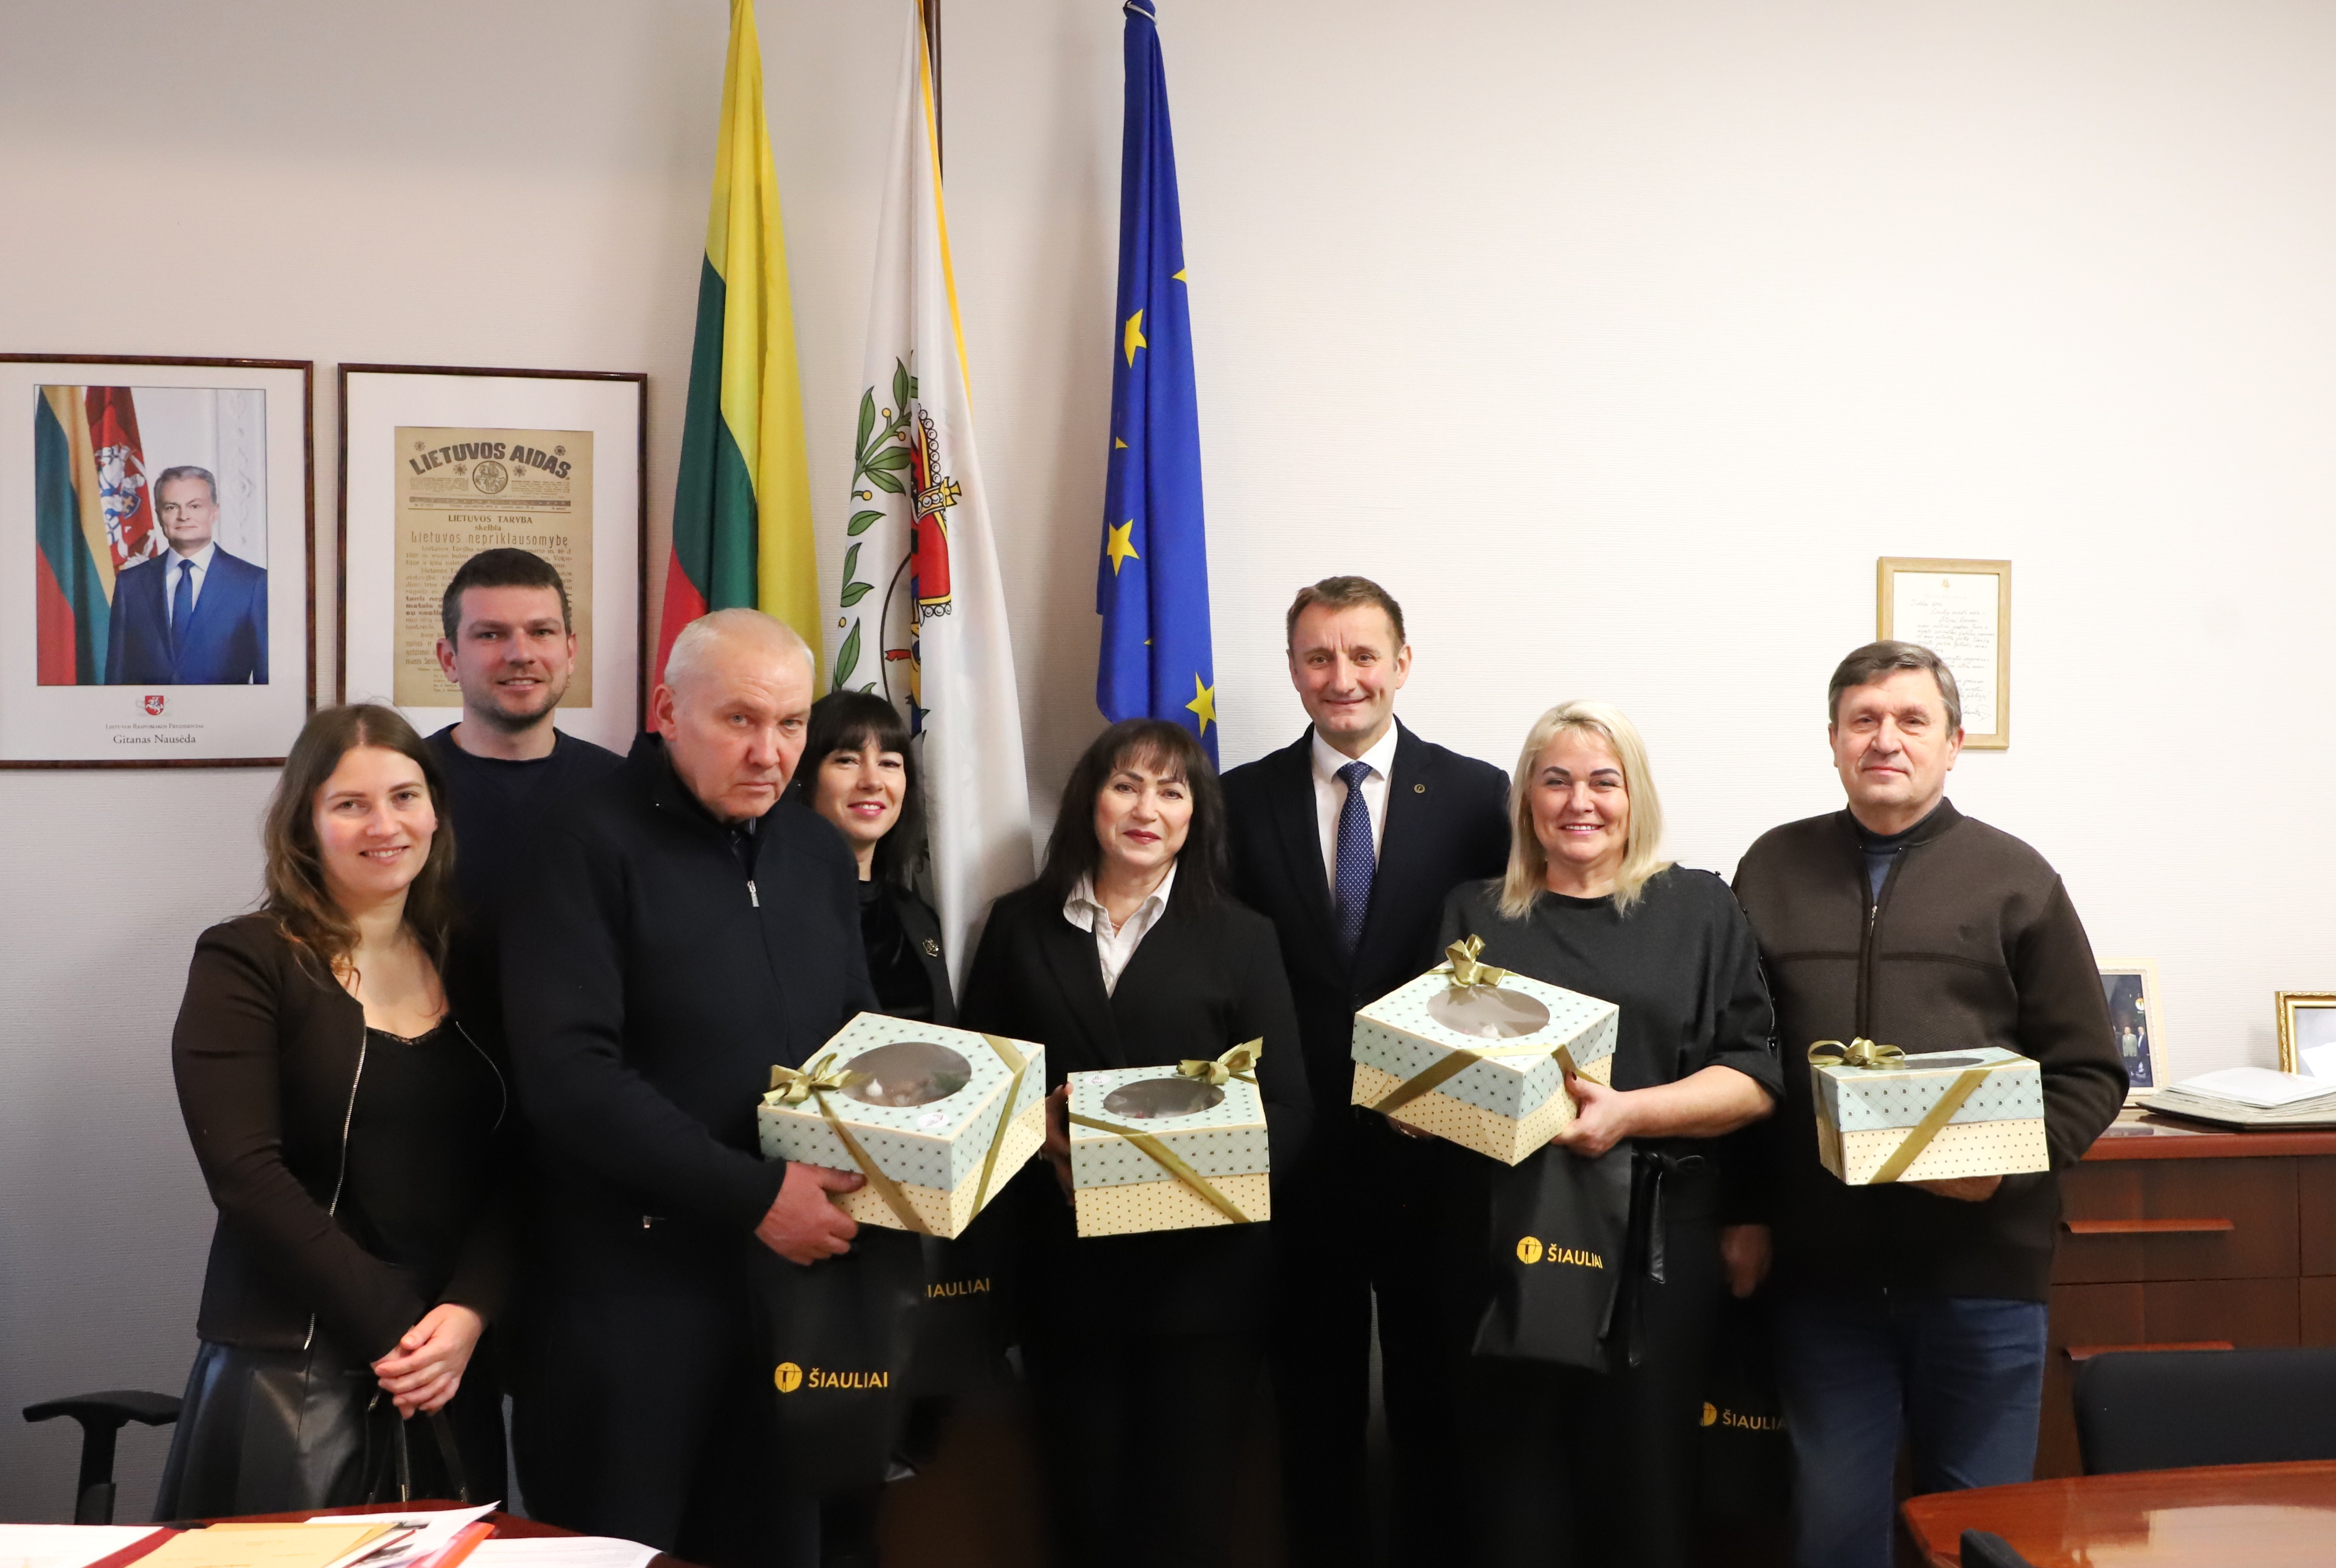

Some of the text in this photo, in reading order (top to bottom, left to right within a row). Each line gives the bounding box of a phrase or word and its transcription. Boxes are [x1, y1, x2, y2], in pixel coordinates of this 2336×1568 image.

[409, 442, 506, 475] LIETUVOS
[411, 531, 568, 548] Lietuvos nepriklausomybę
[113, 734, 196, 744] Gitanas Nausėda
[1547, 1243, 1603, 1269] ŠIAULIAI
[925, 1278, 990, 1298] IAULIAI
[808, 1368, 888, 1388] ŠIAULIAI
